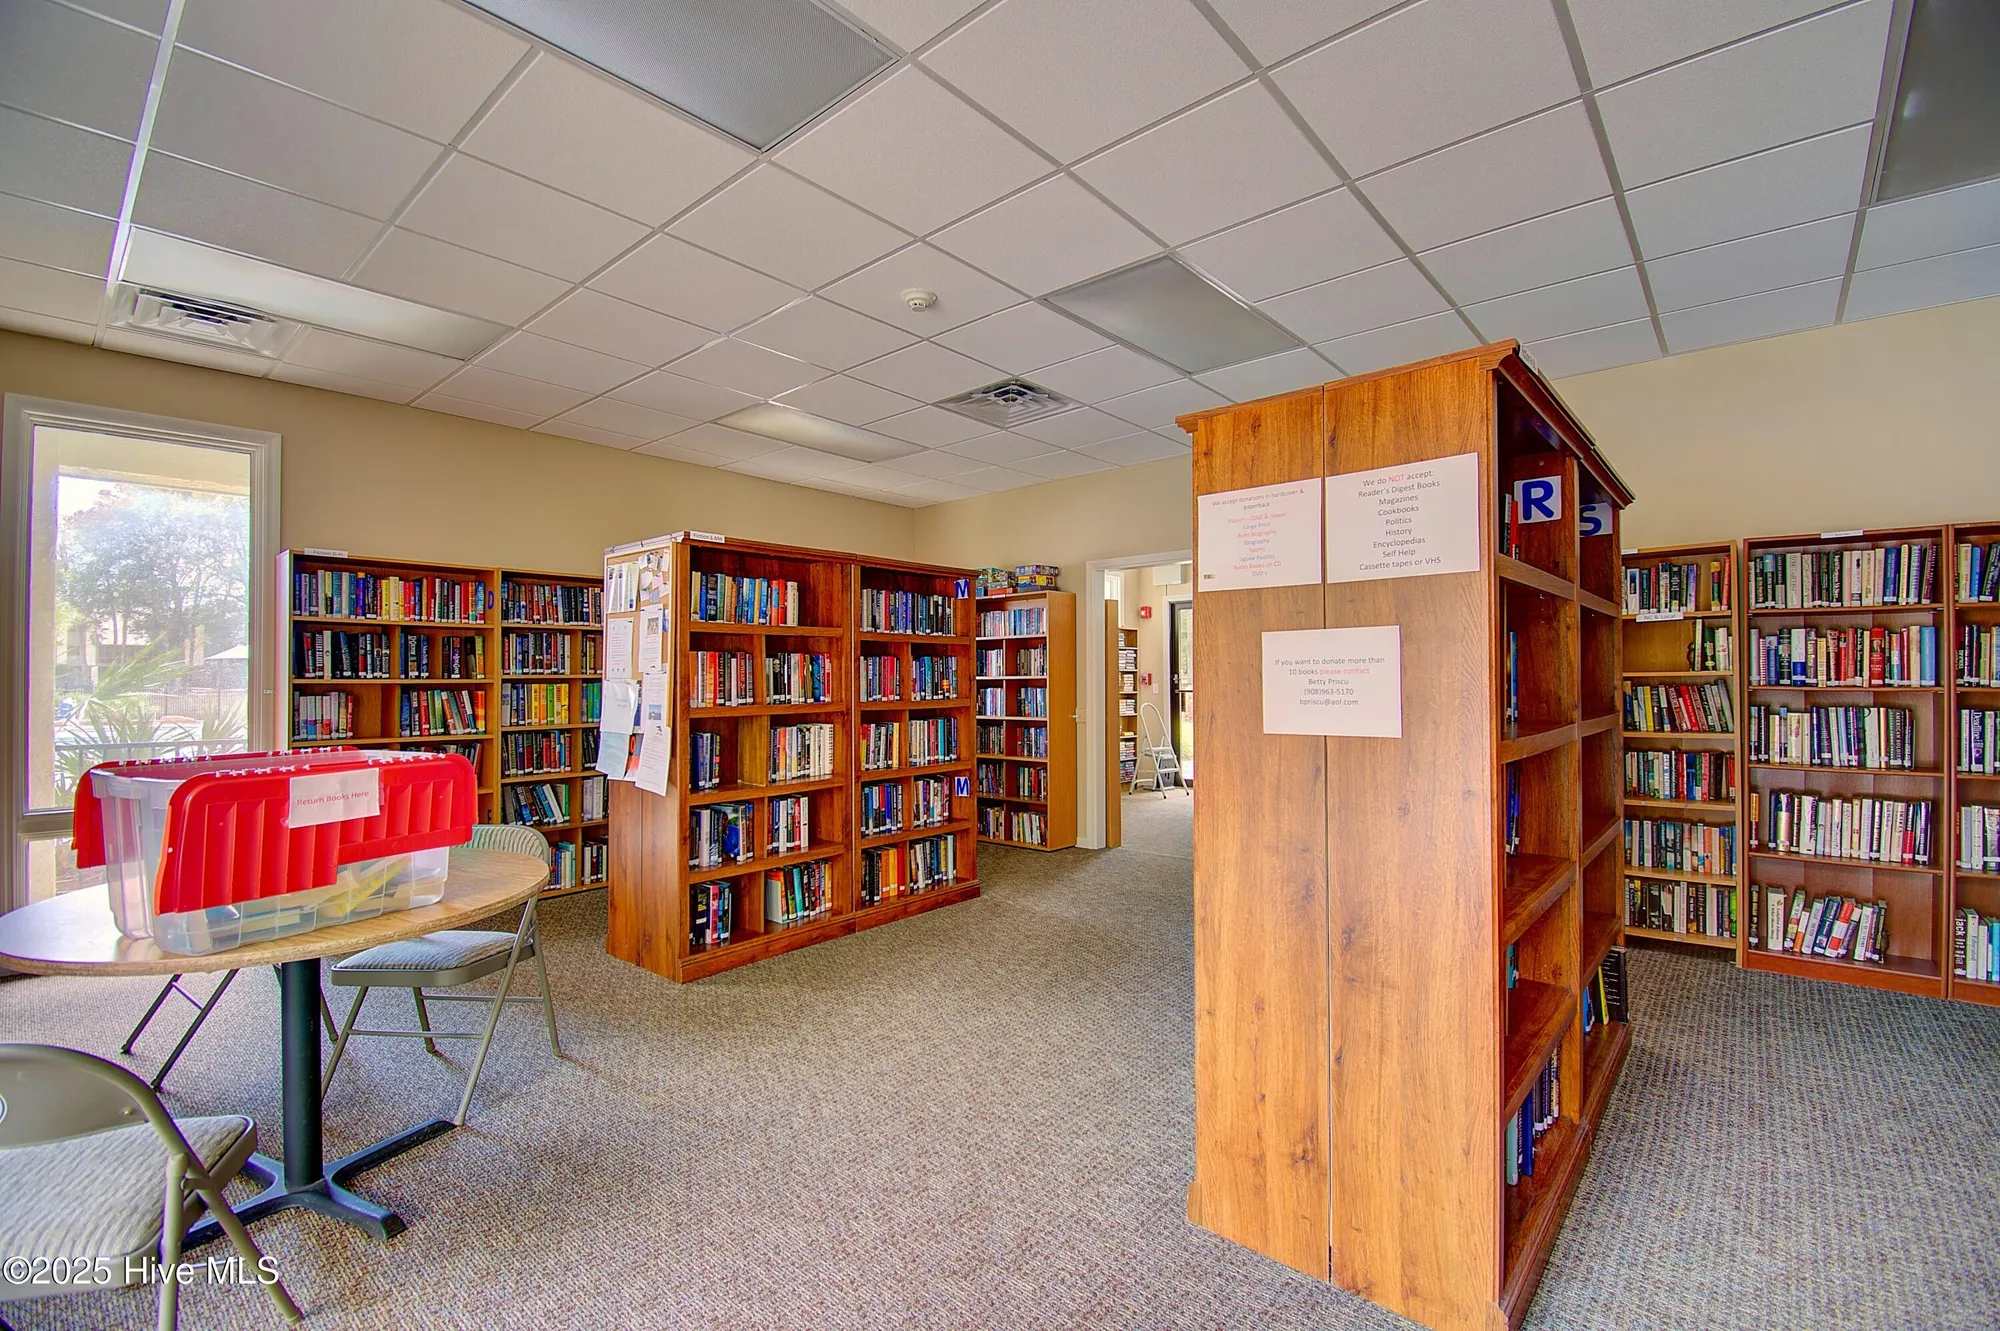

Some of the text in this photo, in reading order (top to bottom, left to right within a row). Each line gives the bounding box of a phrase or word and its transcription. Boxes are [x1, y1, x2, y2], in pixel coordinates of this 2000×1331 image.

[1388, 474, 1405, 483] NOT
[1406, 470, 1434, 481] accept:
[1391, 484, 1415, 494] Digest
[1417, 480, 1441, 490] Books
[1239, 495, 1264, 503] donations
[1271, 490, 1298, 498] hardcover
[1379, 495, 1418, 506] Magazines
[1522, 480, 1554, 520] R
[1243, 502, 1270, 510] paperback
[1378, 505, 1419, 516] Cookbooks
[1385, 517, 1412, 526] Politics
[1580, 504, 1602, 537] S
[1385, 527, 1412, 536] History
[1373, 537, 1426, 548] Encyclopedias
[1382, 549, 1416, 558] Self Help
[1359, 562, 1391, 570] Cassette
[1425, 557, 1441, 565] VHS
[955, 579, 969, 598] M
[1320, 668, 1341, 676] please
[1343, 667, 1370, 675] contact
[1308, 678, 1326, 686] Betty
[957, 777, 969, 796] M
[297, 797, 324, 806] Return
[326, 794, 350, 802] Books
